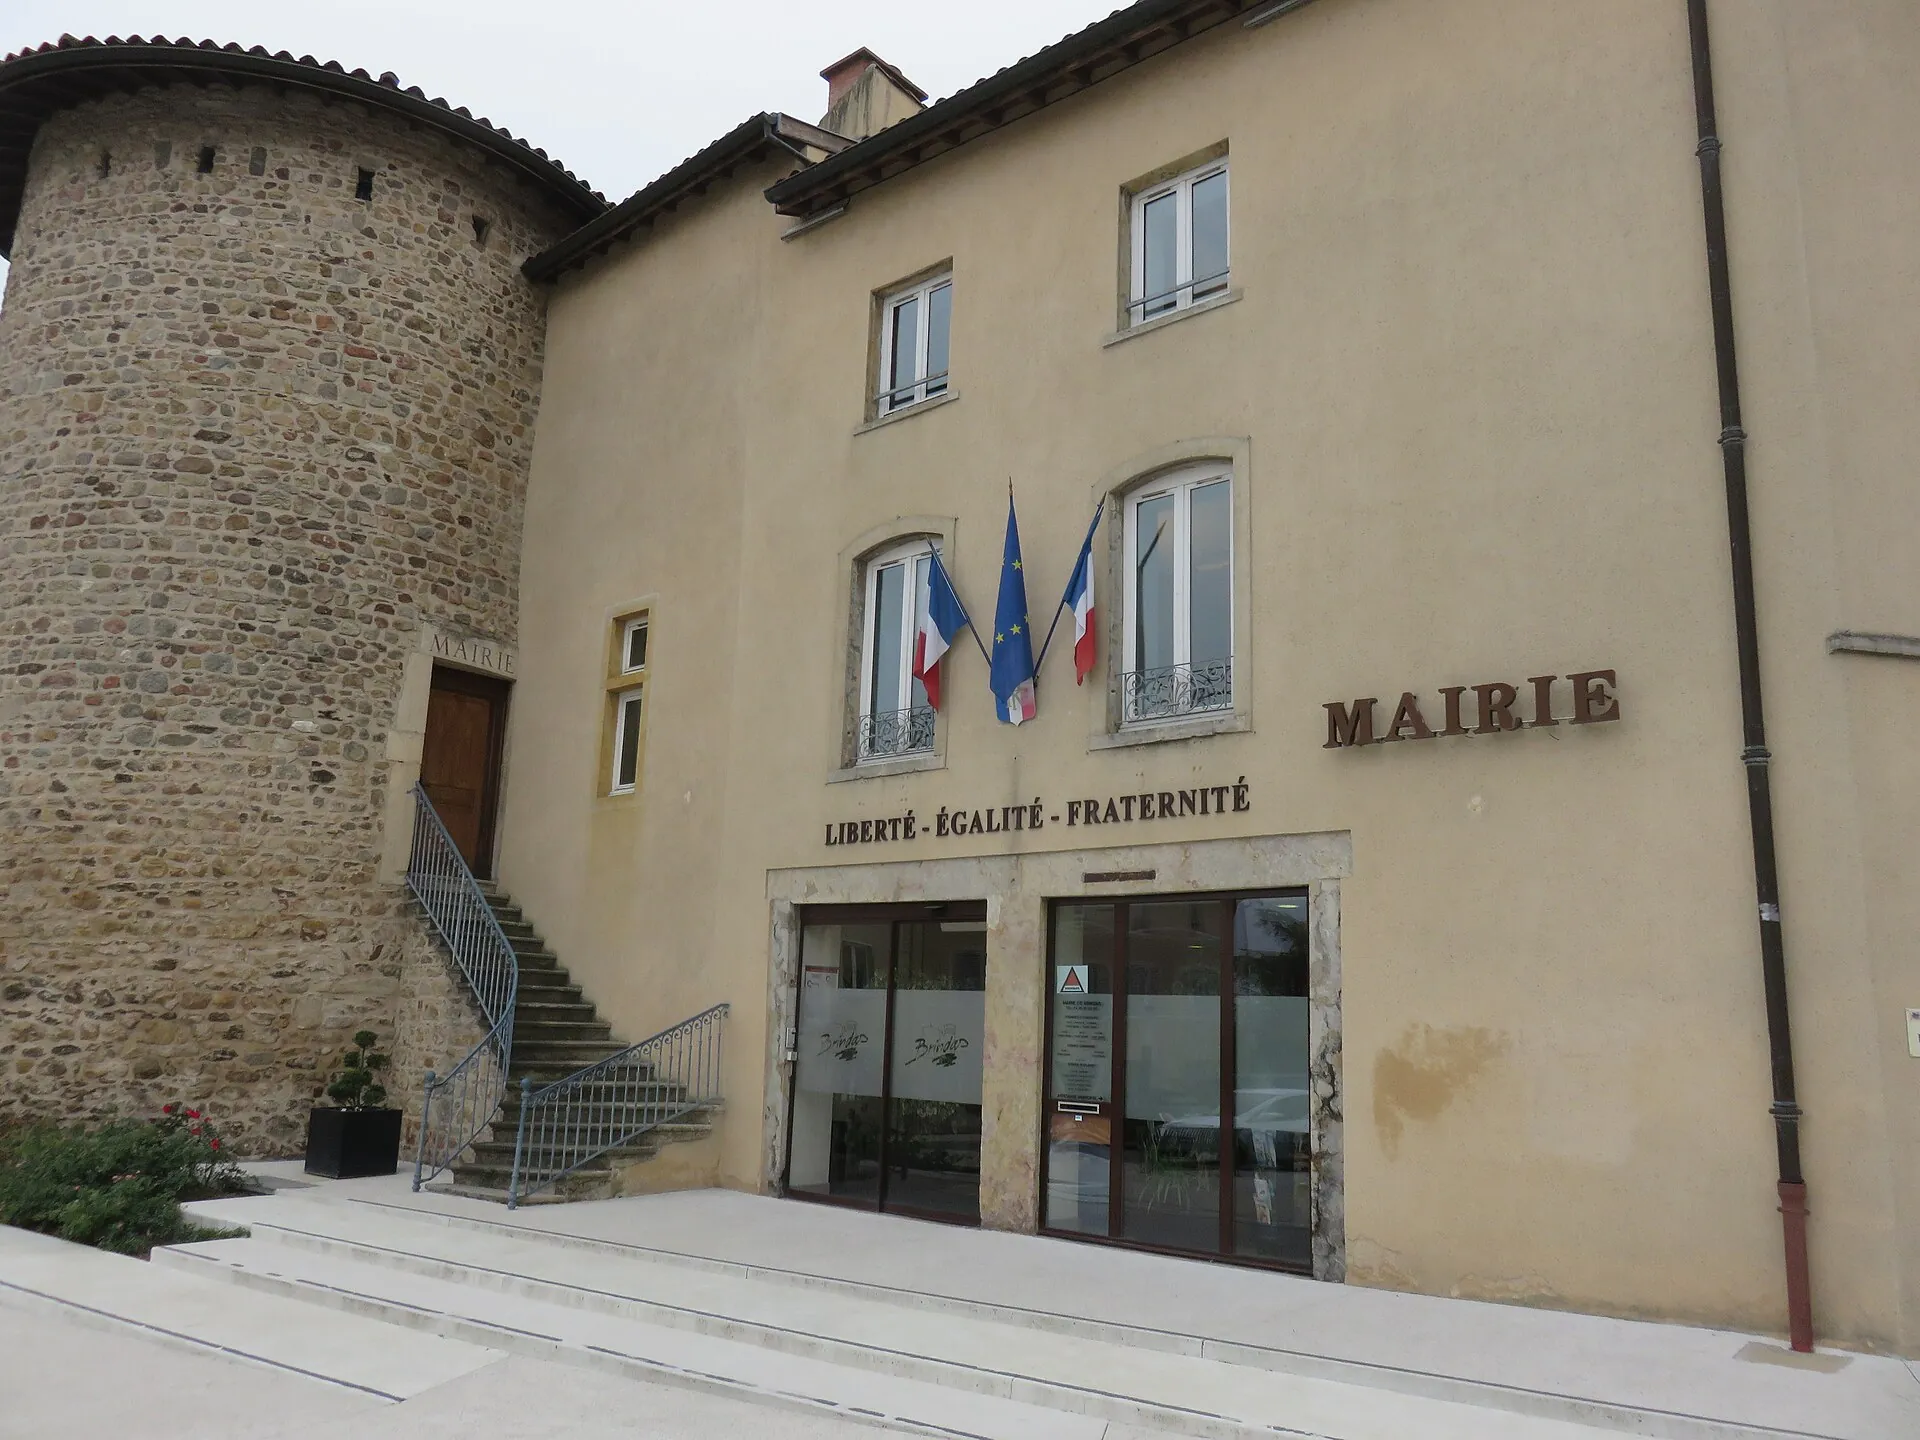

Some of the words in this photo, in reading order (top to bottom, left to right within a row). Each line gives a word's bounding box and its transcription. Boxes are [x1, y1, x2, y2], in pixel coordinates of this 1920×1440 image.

[429, 634, 514, 674] MAIRIE
[1322, 669, 1621, 748] MAIRIE
[825, 809, 916, 845] LIBERTÉ
[935, 797, 1043, 836] ÉGALITÉ
[1066, 776, 1251, 826] FRATERNITÉ
[905, 1036, 969, 1066] Brindas
